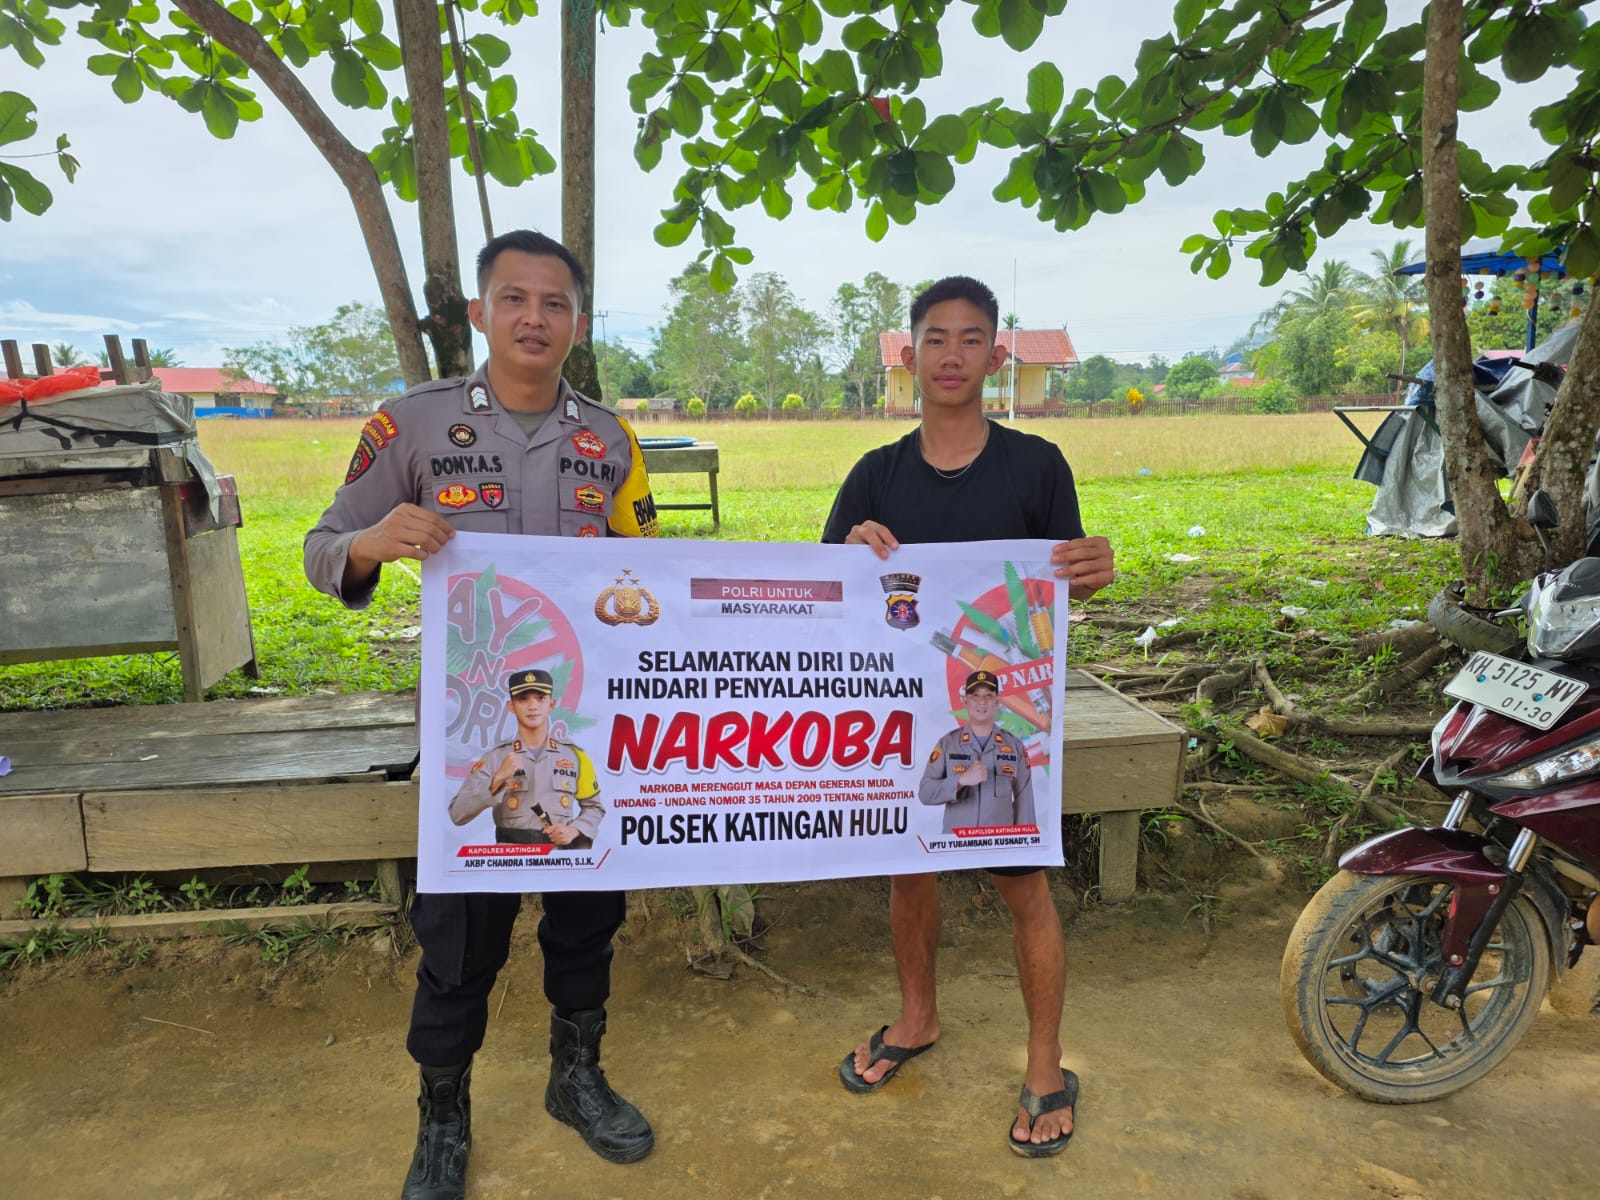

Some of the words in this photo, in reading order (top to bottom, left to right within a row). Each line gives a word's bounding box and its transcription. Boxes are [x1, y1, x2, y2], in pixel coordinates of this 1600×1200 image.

[431, 455, 502, 476] DONY.A.S
[560, 457, 616, 482] POLRI
[722, 586, 762, 598] POLRI
[767, 587, 813, 599] UNTUK
[721, 602, 815, 615] MASYARAKAT
[638, 651, 790, 672] SELAMATKAN
[798, 651, 842, 672] DIRI
[850, 652, 894, 672] DAN
[607, 678, 707, 700] HINDARI
[715, 677, 924, 699] PENYALAHGUNAAN
[1465, 654, 1494, 676] KH
[1492, 662, 1543, 690] 5125
[1544, 679, 1582, 702] NV
[606, 710, 914, 772] NARKOBA
[639, 783, 688, 794] NARKOBA
[691, 781, 753, 793] MERENGGUT
[755, 781, 782, 791] MASA
[785, 780, 816, 790] DEPAN
[819, 779, 864, 789] GENERASI
[868, 778, 894, 788] MUDA
[613, 798, 656, 809] UNDANG
[664, 797, 706, 807] UNDANG
[709, 795, 746, 806] NOMOR
[748, 795, 761, 805] 35
[764, 794, 795, 804] TAHUN
[797, 793, 821, 803] 2009
[824, 792, 864, 803] TENTANG
[867, 790, 915, 801] NARKOTIKA
[621, 813, 718, 846] POLSEK
[725, 809, 843, 843] KATINGAN
[849, 807, 908, 836] HULU
[929, 841, 946, 850] IPTU
[1031, 836, 1041, 844] SH
[464, 859, 485, 868] AKBP
[487, 859, 523, 867] CHANDRA
